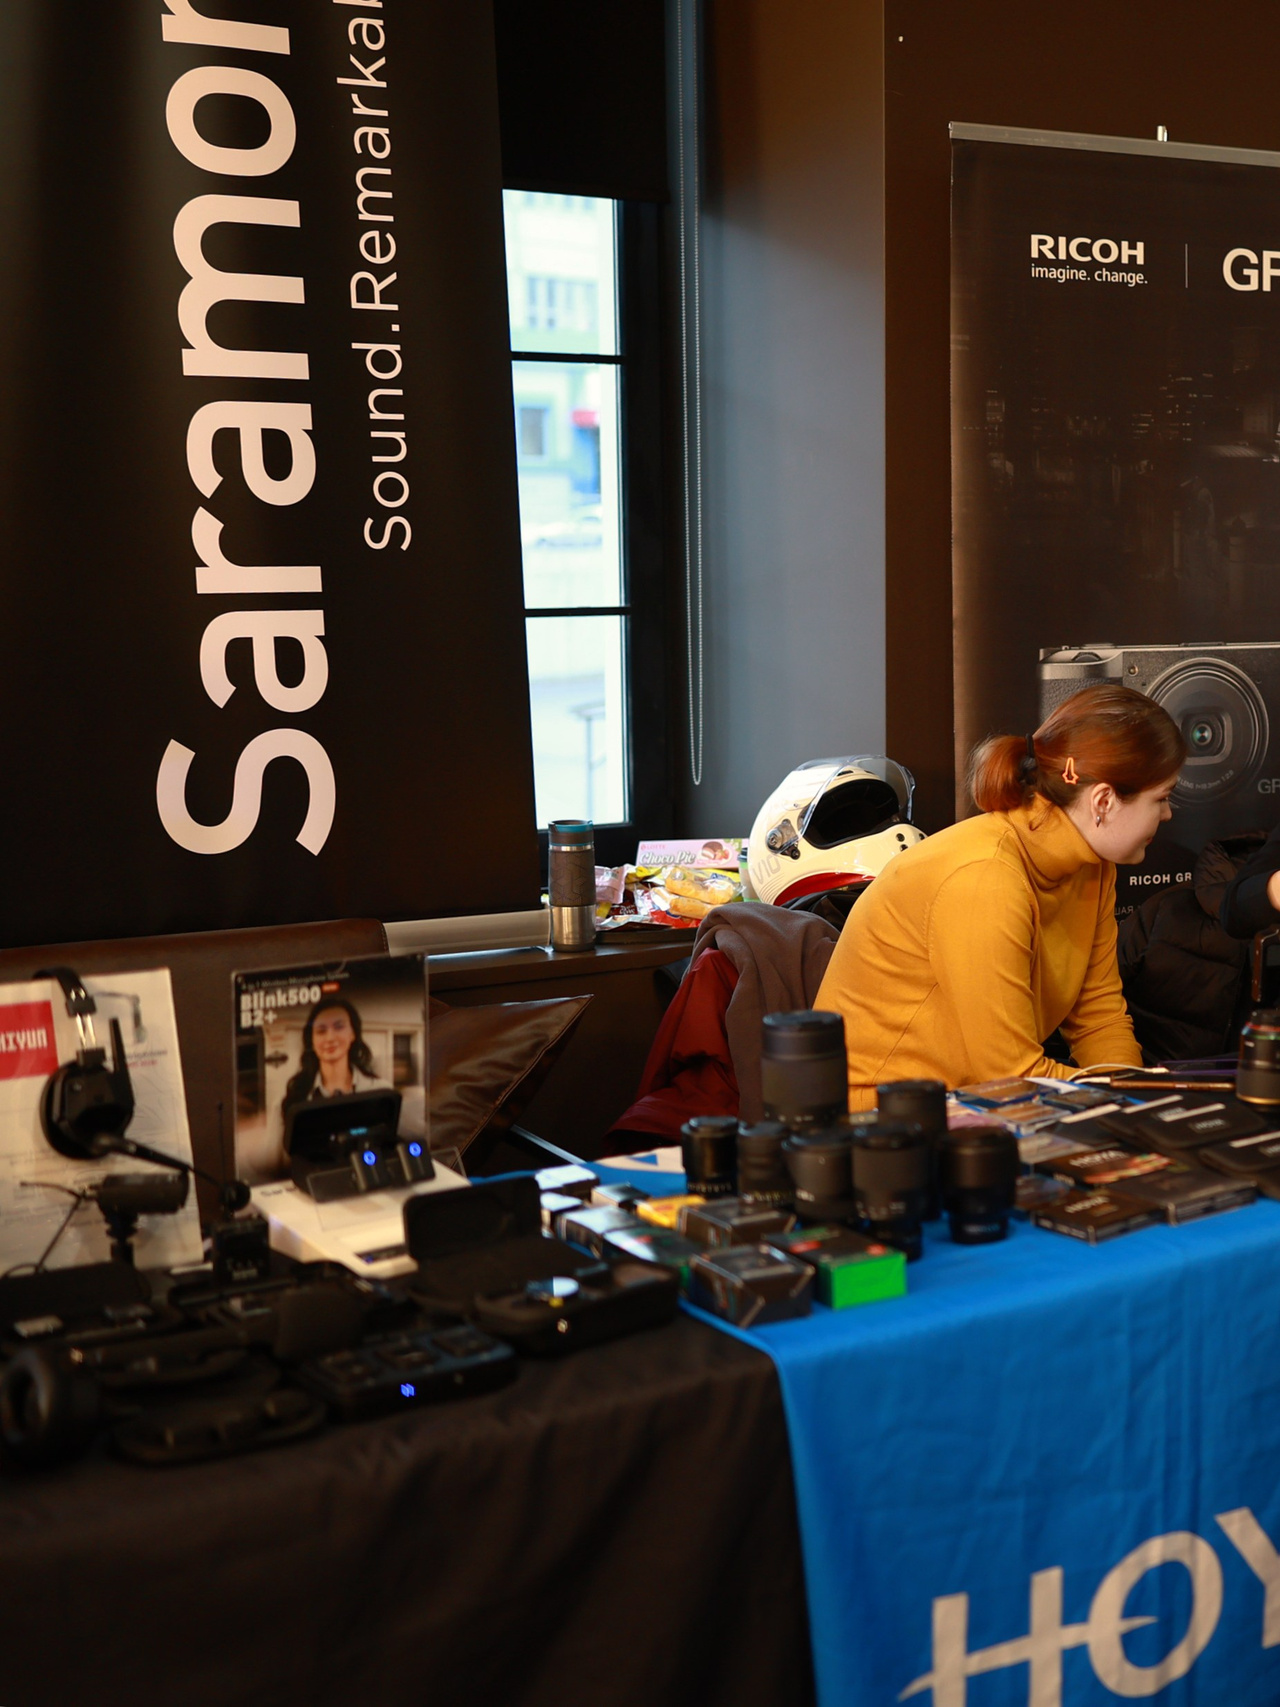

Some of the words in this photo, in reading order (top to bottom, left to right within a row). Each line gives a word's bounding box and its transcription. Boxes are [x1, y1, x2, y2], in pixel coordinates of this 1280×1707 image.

[1030, 234, 1145, 265] RICOH
[332, 0, 411, 551] Sound.Remarka
[1031, 263, 1091, 282] imagine.
[1094, 267, 1148, 287] change.
[638, 851, 674, 865] Choco
[675, 851, 697, 865] Pie
[1129, 874, 1171, 886] RICOH
[1175, 871, 1193, 884] GR
[240, 984, 322, 1011] Blink500
